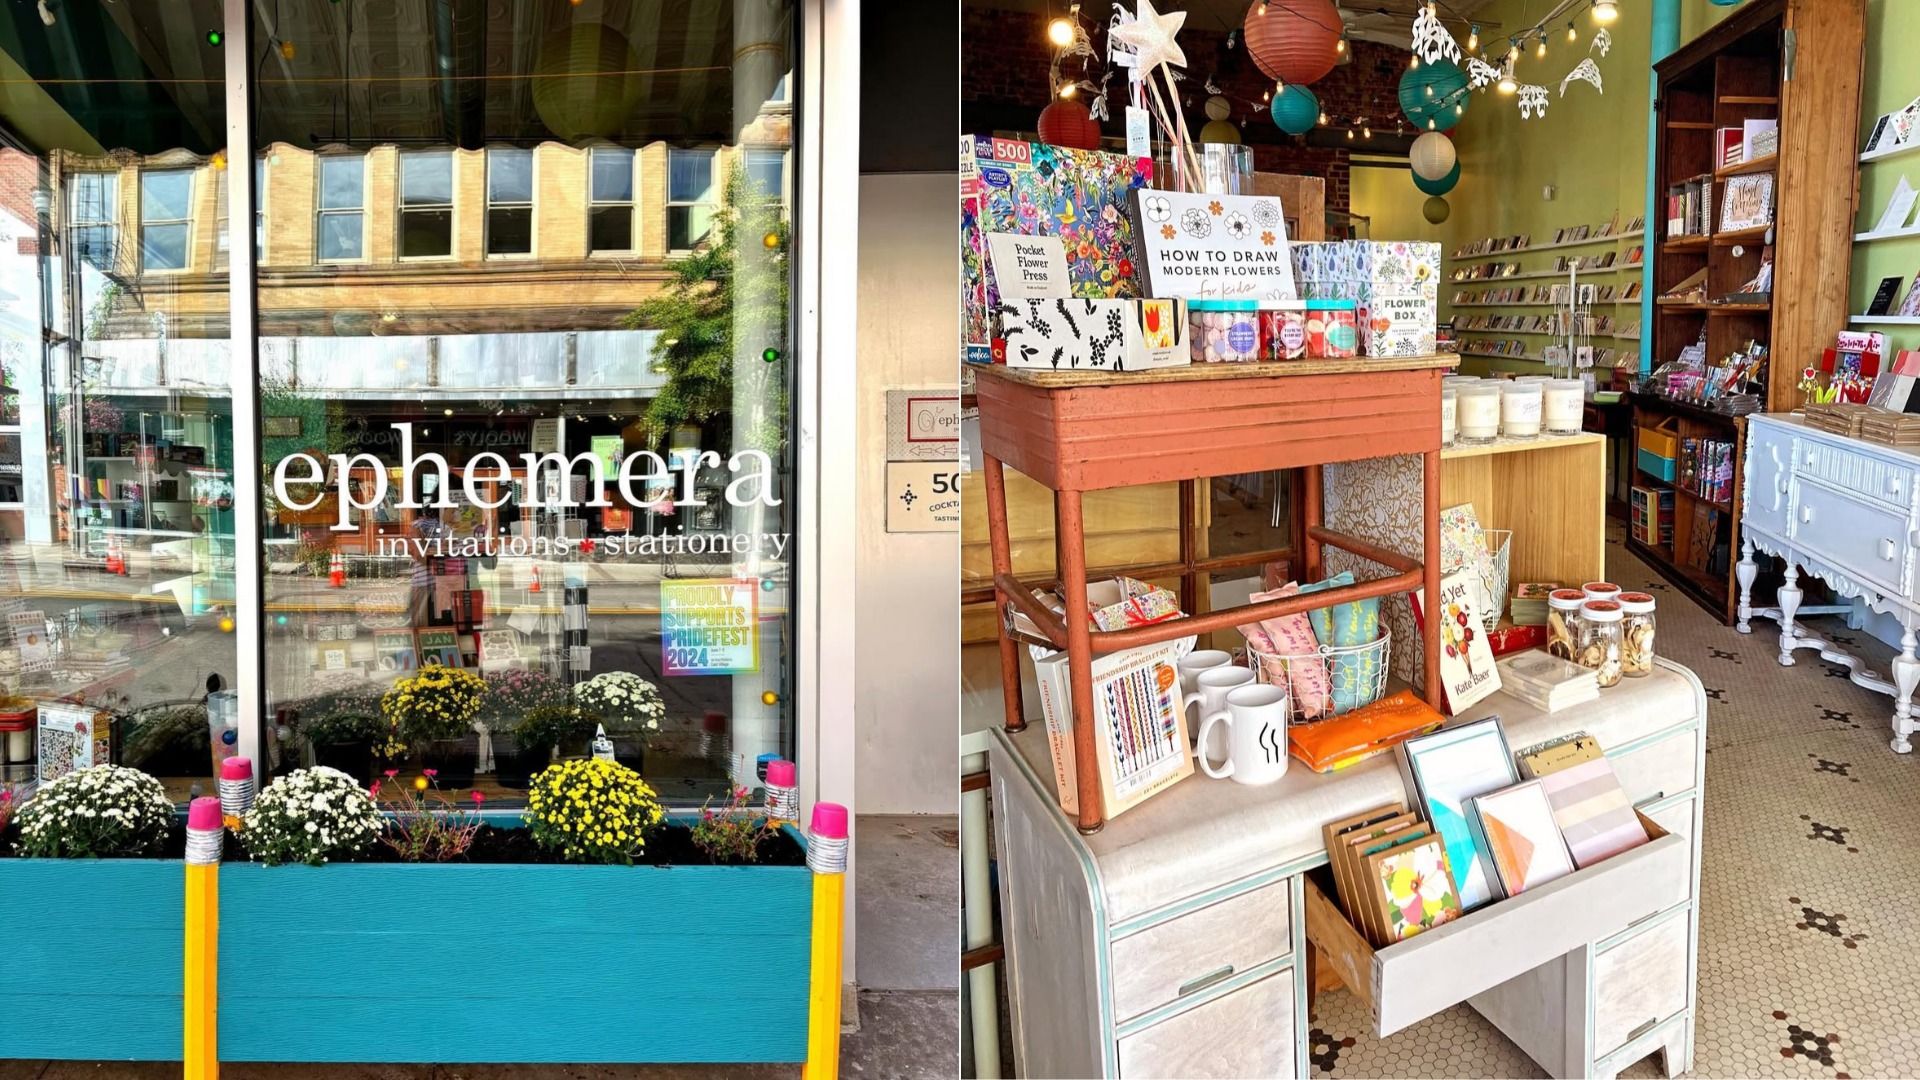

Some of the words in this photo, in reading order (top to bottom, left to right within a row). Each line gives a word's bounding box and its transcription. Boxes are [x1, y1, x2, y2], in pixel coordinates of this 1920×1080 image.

[996, 142, 1027, 161] 500
[1015, 243, 1046, 256] Pocket
[1160, 249, 1201, 263] HOW
[1205, 250, 1227, 262] TO
[1233, 250, 1278, 262] DRAW
[1017, 256, 1049, 268] Flower
[1163, 265, 1219, 276] MODERN
[1224, 265, 1281, 276] FLOWERS
[1022, 269, 1048, 281] Press
[1195, 279, 1217, 300] for
[1384, 299, 1426, 308] FLOWER
[1394, 311, 1416, 320] BOX
[273, 421, 783, 532] ephemera
[378, 528, 570, 558] invitations
[604, 524, 791, 562] stationery
[666, 585, 735, 607] PROUDLY
[1448, 583, 1467, 601] Yet
[667, 606, 746, 627] SUPPORTS
[426, 635, 453, 645] JAN
[667, 626, 750, 648] PRIDEFEST
[667, 647, 709, 668] 2024
[1092, 664, 1130, 683] FRIENDSHIP
[1130, 652, 1160, 668] BRACELET
[1159, 647, 1169, 656] KIT
[1455, 680, 1473, 696] Kate
[1472, 669, 1490, 685] Baer
